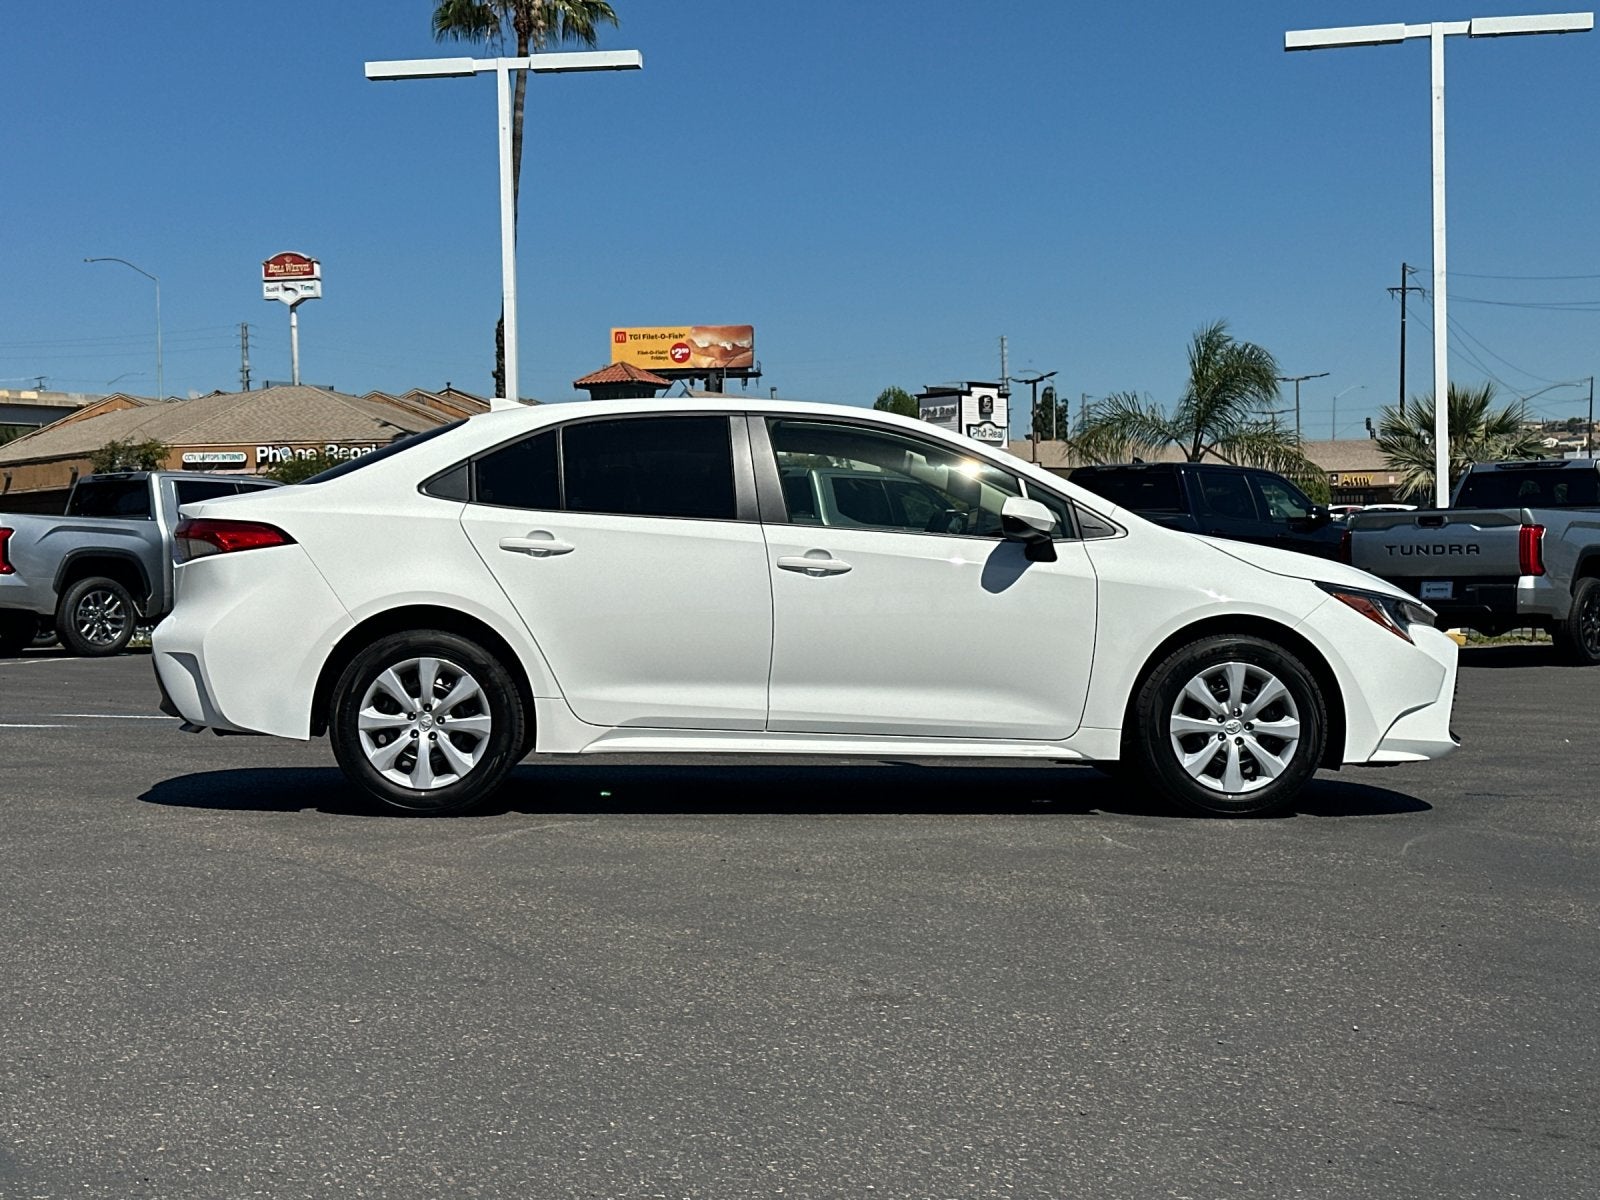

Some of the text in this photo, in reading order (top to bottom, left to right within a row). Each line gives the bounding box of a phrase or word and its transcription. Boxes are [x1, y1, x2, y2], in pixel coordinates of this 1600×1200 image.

[988, 428, 1003, 439] Real
[222, 453, 244, 461] INTERNET
[325, 444, 377, 460] Repai
[1384, 543, 1480, 556] TUNDRA
